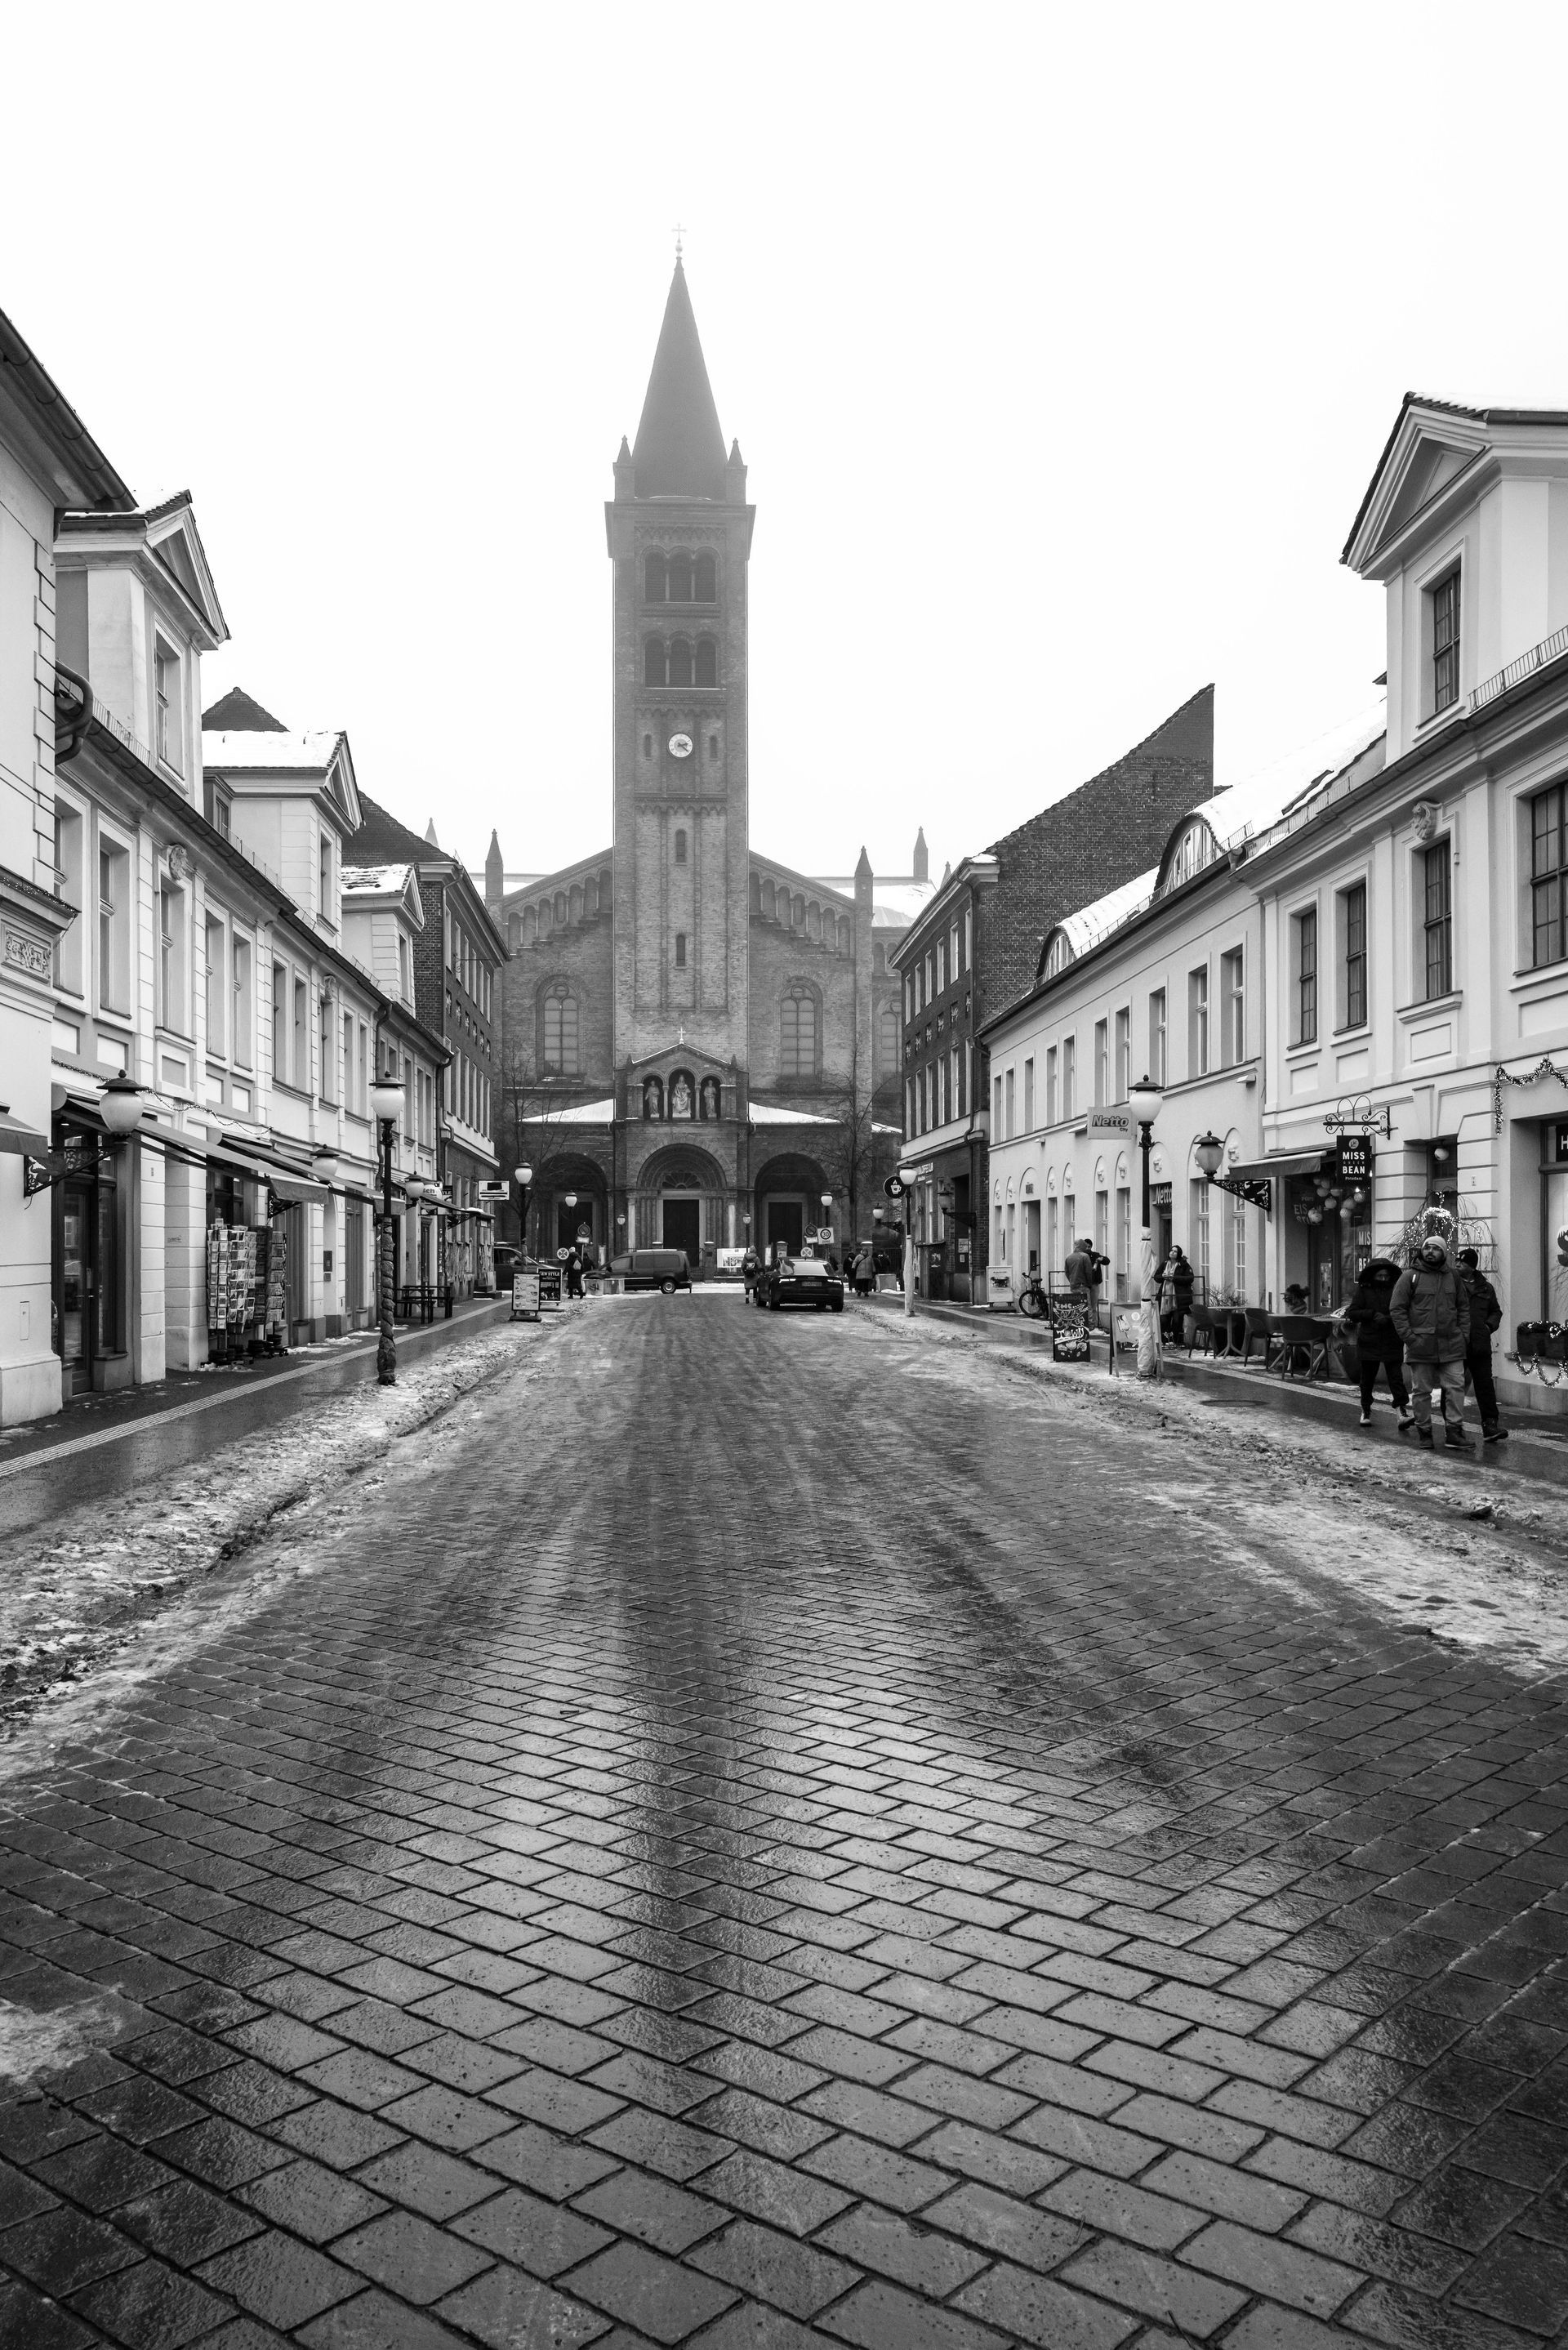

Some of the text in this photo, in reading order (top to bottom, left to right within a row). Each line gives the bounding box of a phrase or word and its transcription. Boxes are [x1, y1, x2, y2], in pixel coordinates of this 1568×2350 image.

[1092, 1115, 1129, 1127] Netto
[1343, 1152, 1365, 1160] MISS
[1343, 1166, 1365, 1174] BEAN
[1155, 1185, 1172, 1205] Netto
[1056, 1327, 1085, 1339] TOWN
